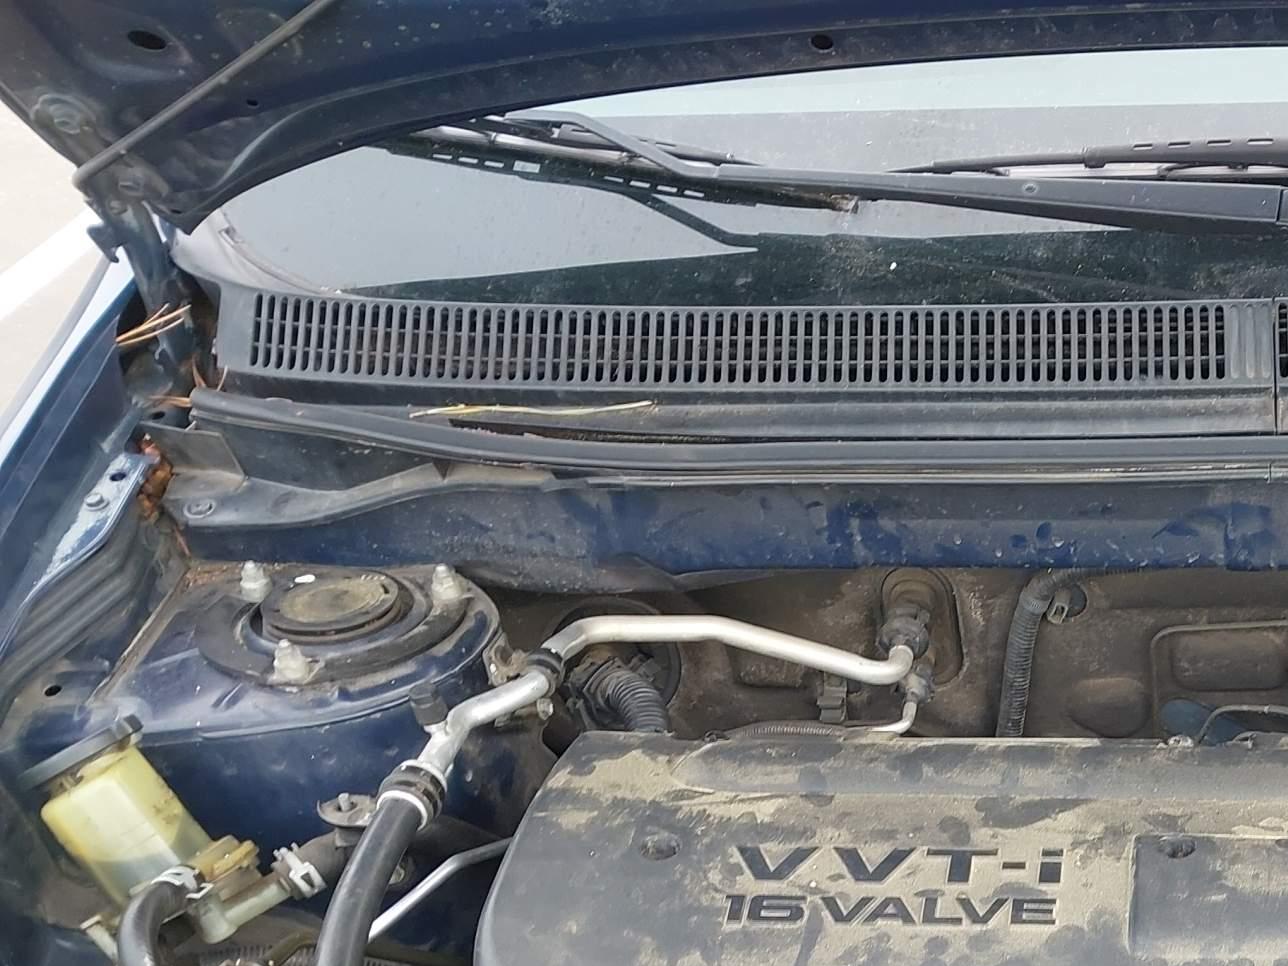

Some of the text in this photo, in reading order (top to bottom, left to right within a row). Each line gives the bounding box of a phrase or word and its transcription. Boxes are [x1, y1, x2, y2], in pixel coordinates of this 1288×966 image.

[735, 847, 1065, 884] VVT-i
[724, 895, 1057, 926] 16 VALVE
